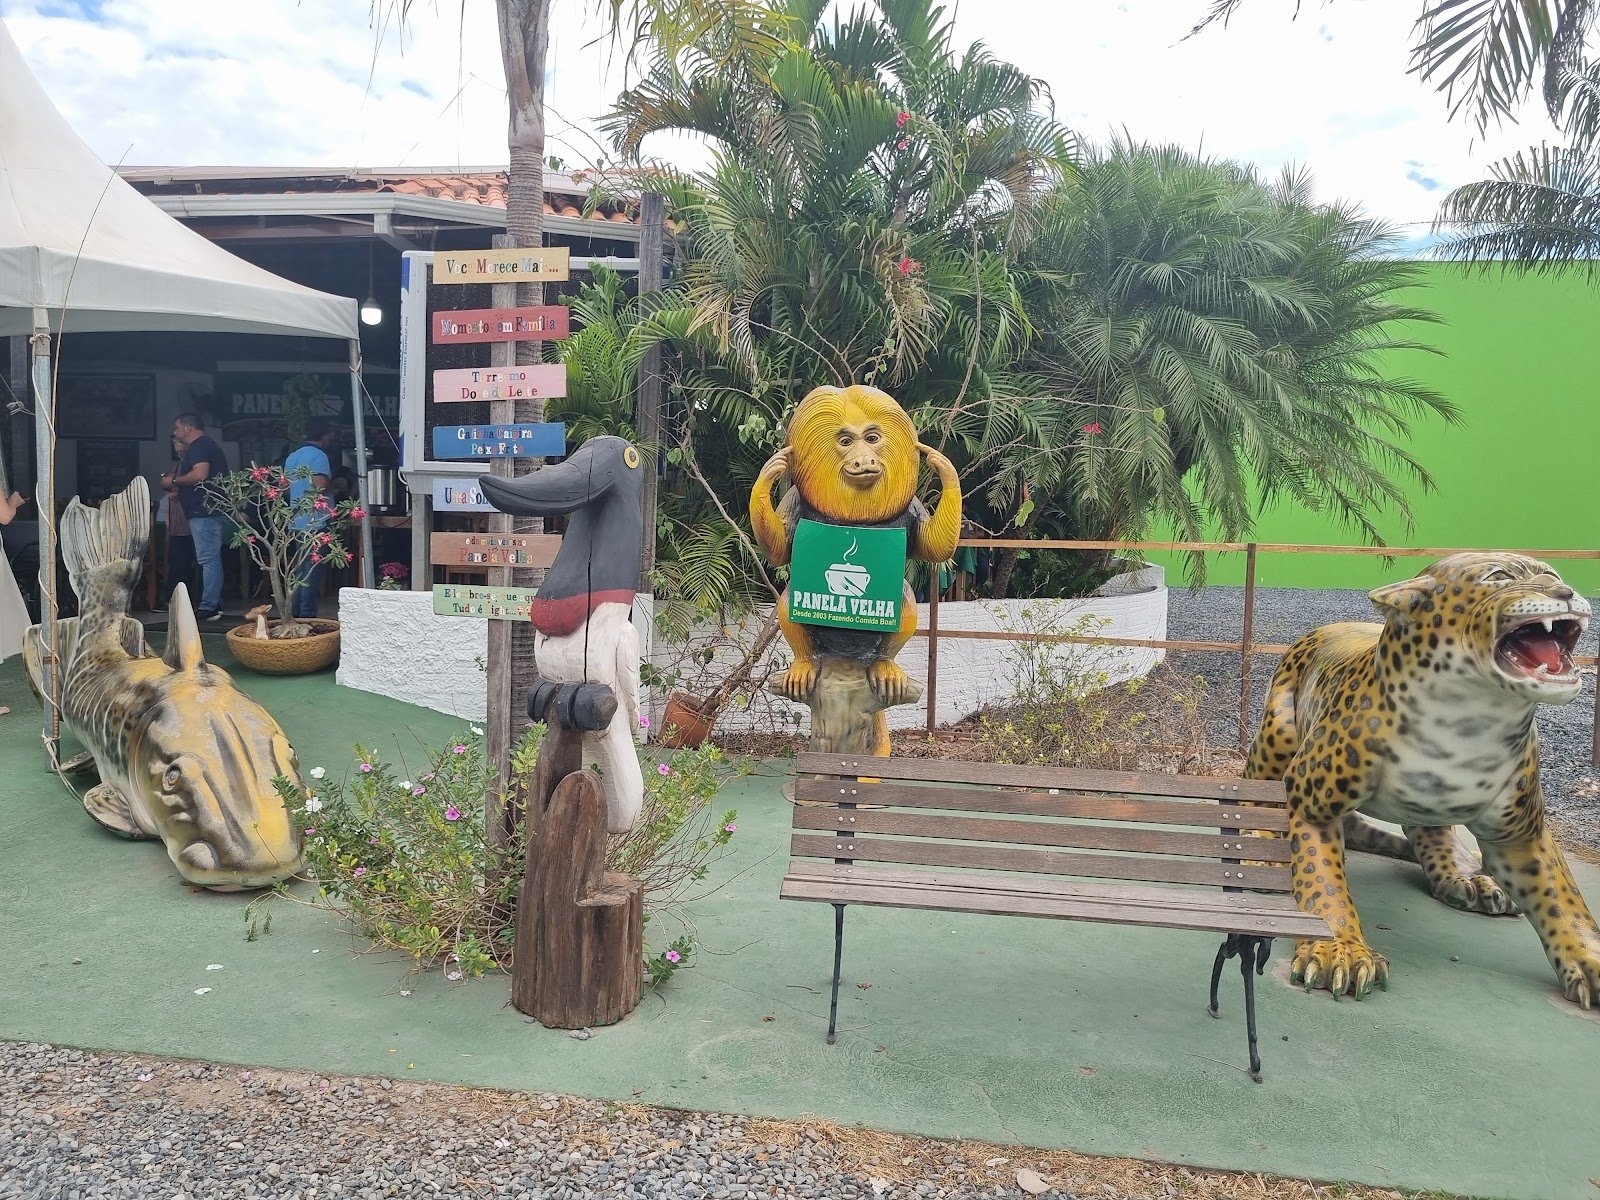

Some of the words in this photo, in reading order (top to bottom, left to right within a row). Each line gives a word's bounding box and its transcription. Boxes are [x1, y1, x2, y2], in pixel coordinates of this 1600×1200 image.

[476, 258, 518, 274] Merece
[497, 321, 513, 333] em
[515, 315, 555, 332] Família
[472, 371, 526, 383] Torresmo
[508, 384, 538, 398] Leite
[496, 427, 533, 442] Caipira
[471, 443, 496, 455] Peixe
[445, 487, 468, 504] Uma
[460, 548, 499, 564] Panela
[500, 548, 533, 565] Velha
[444, 588, 451, 598] E
[453, 603, 475, 614] Tudo
[478, 604, 483, 613] é
[793, 590, 847, 613] PANELA
[850, 598, 895, 618] VELHA
[792, 608, 812, 618] Desde
[828, 613, 853, 623] Fazendo
[855, 616, 879, 625] Comida
